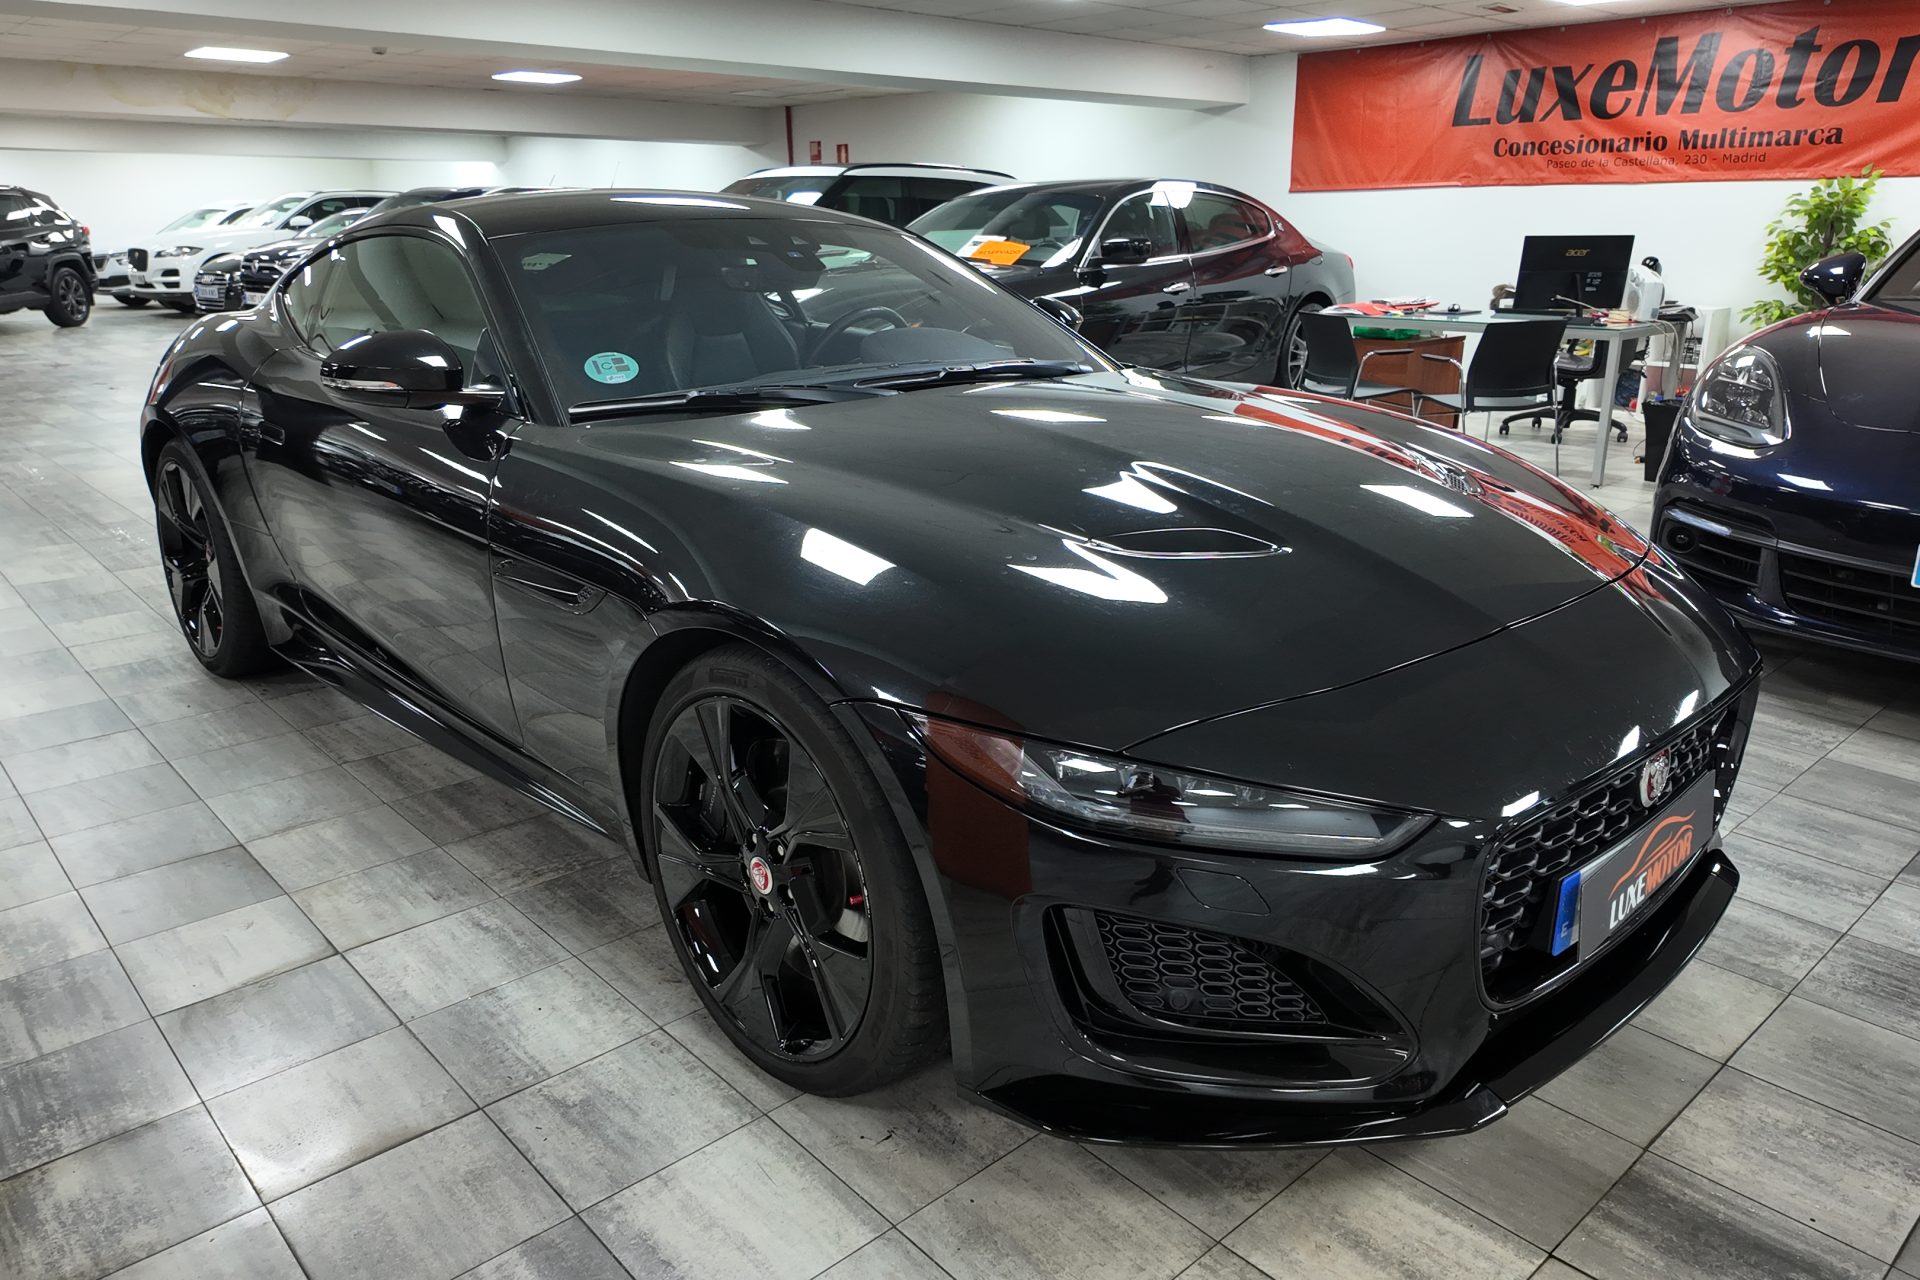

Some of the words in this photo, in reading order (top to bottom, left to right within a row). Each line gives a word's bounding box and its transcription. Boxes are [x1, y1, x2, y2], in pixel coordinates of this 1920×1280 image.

[1452, 25, 1920, 127] LuxeMotor
[1493, 131, 1668, 158] Concesionario
[1678, 126, 1844, 151] Multimarca
[1546, 159, 1577, 169] Paseo
[1581, 158, 1595, 168] de
[1599, 158, 1609, 167] la
[1613, 155, 1679, 167] Castellana,
[1684, 153, 1708, 165] 230
[1721, 152, 1767, 164] Madrid
[1565, 248, 1591, 257] acer
[1609, 831, 1693, 930] LUXEMOTOR
[1561, 921, 1569, 938] E
